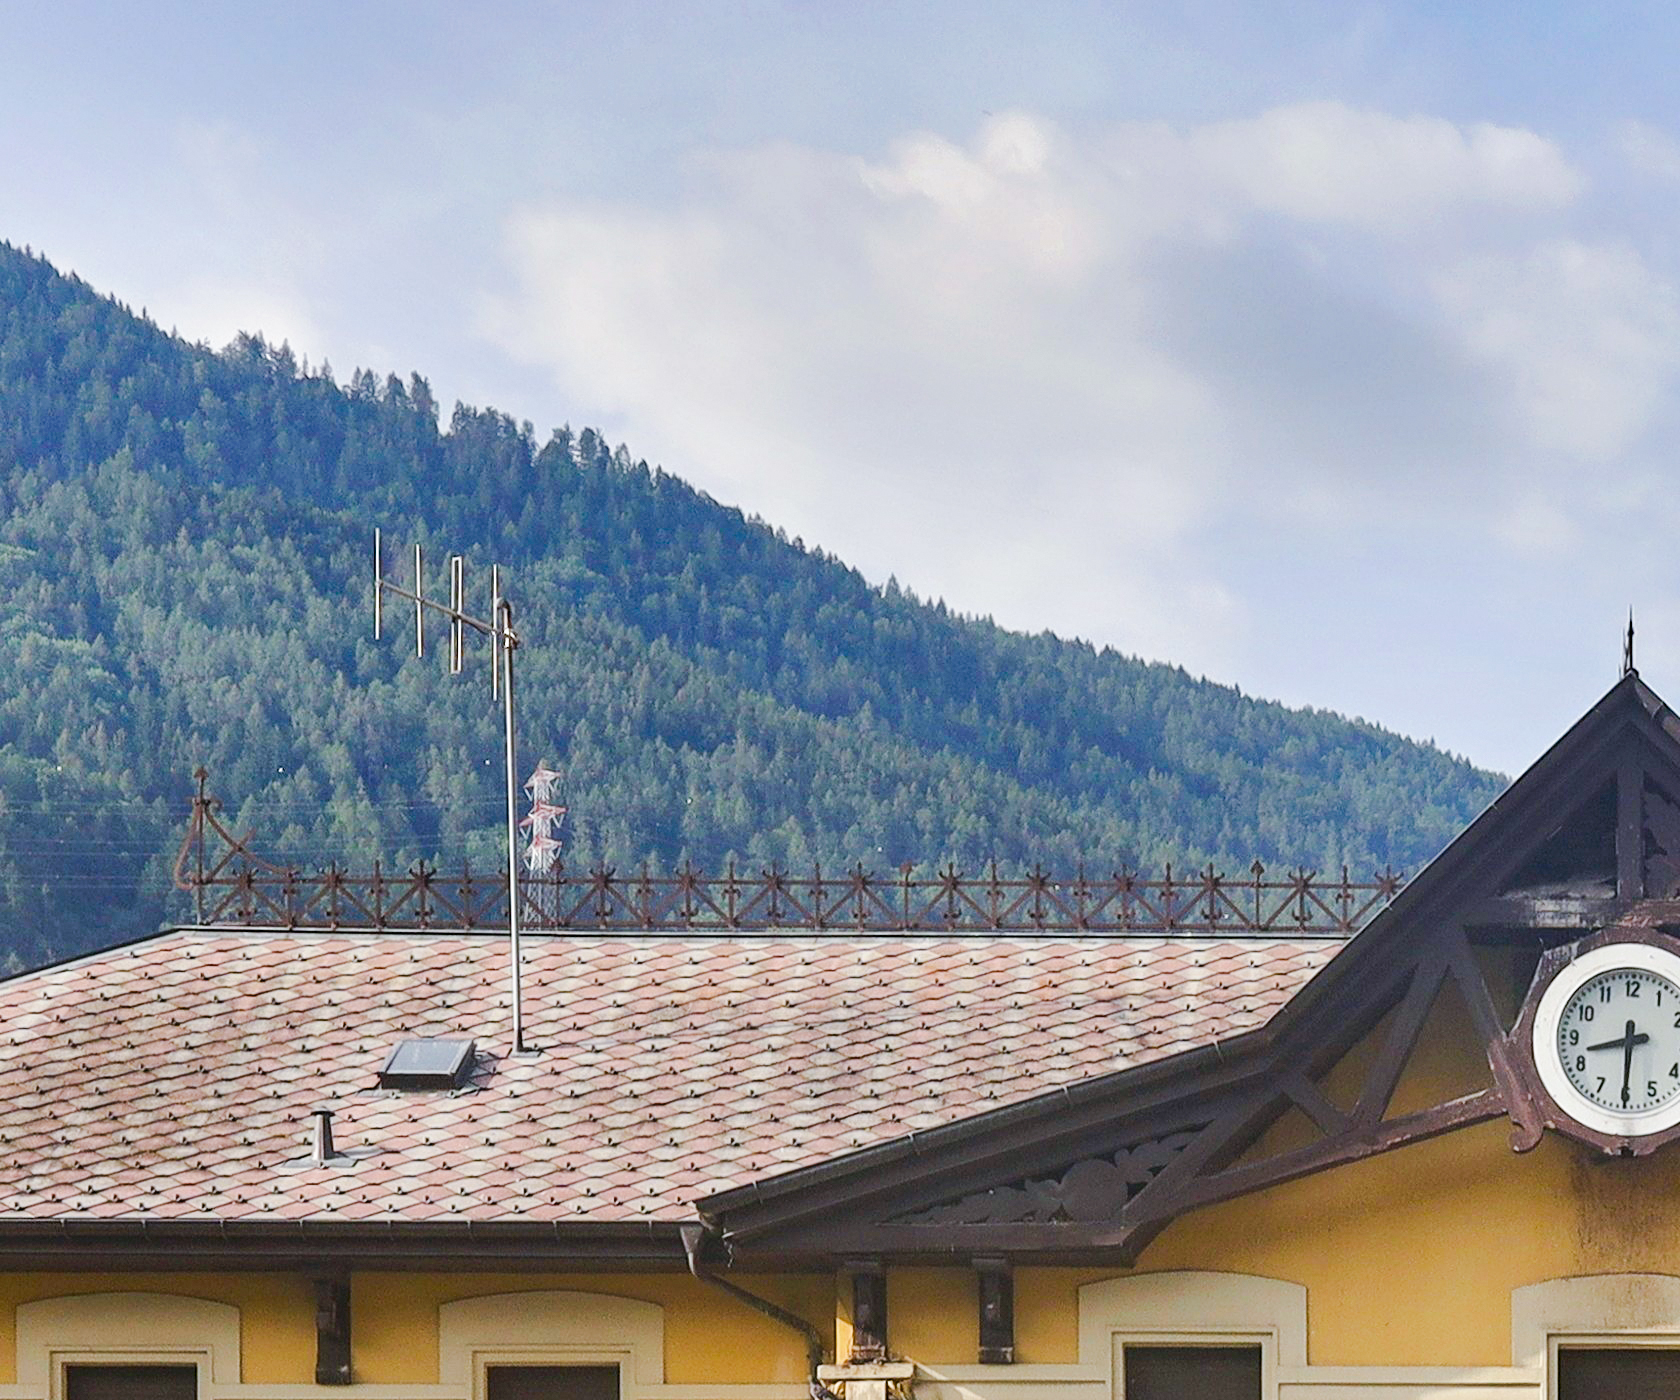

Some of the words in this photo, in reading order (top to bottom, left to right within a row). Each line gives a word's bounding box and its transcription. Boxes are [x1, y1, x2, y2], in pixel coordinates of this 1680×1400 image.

[1600, 985, 1611, 1003] 11
[1625, 980, 1641, 998] 12
[1579, 1004, 1594, 1022] 10
[1569, 1029, 1579, 1046] 9
[1576, 1055, 1586, 1072] 8
[1668, 1062, 1679, 1079] 4
[1596, 1076, 1606, 1093] 7
[1647, 1081, 1658, 1097] 5
